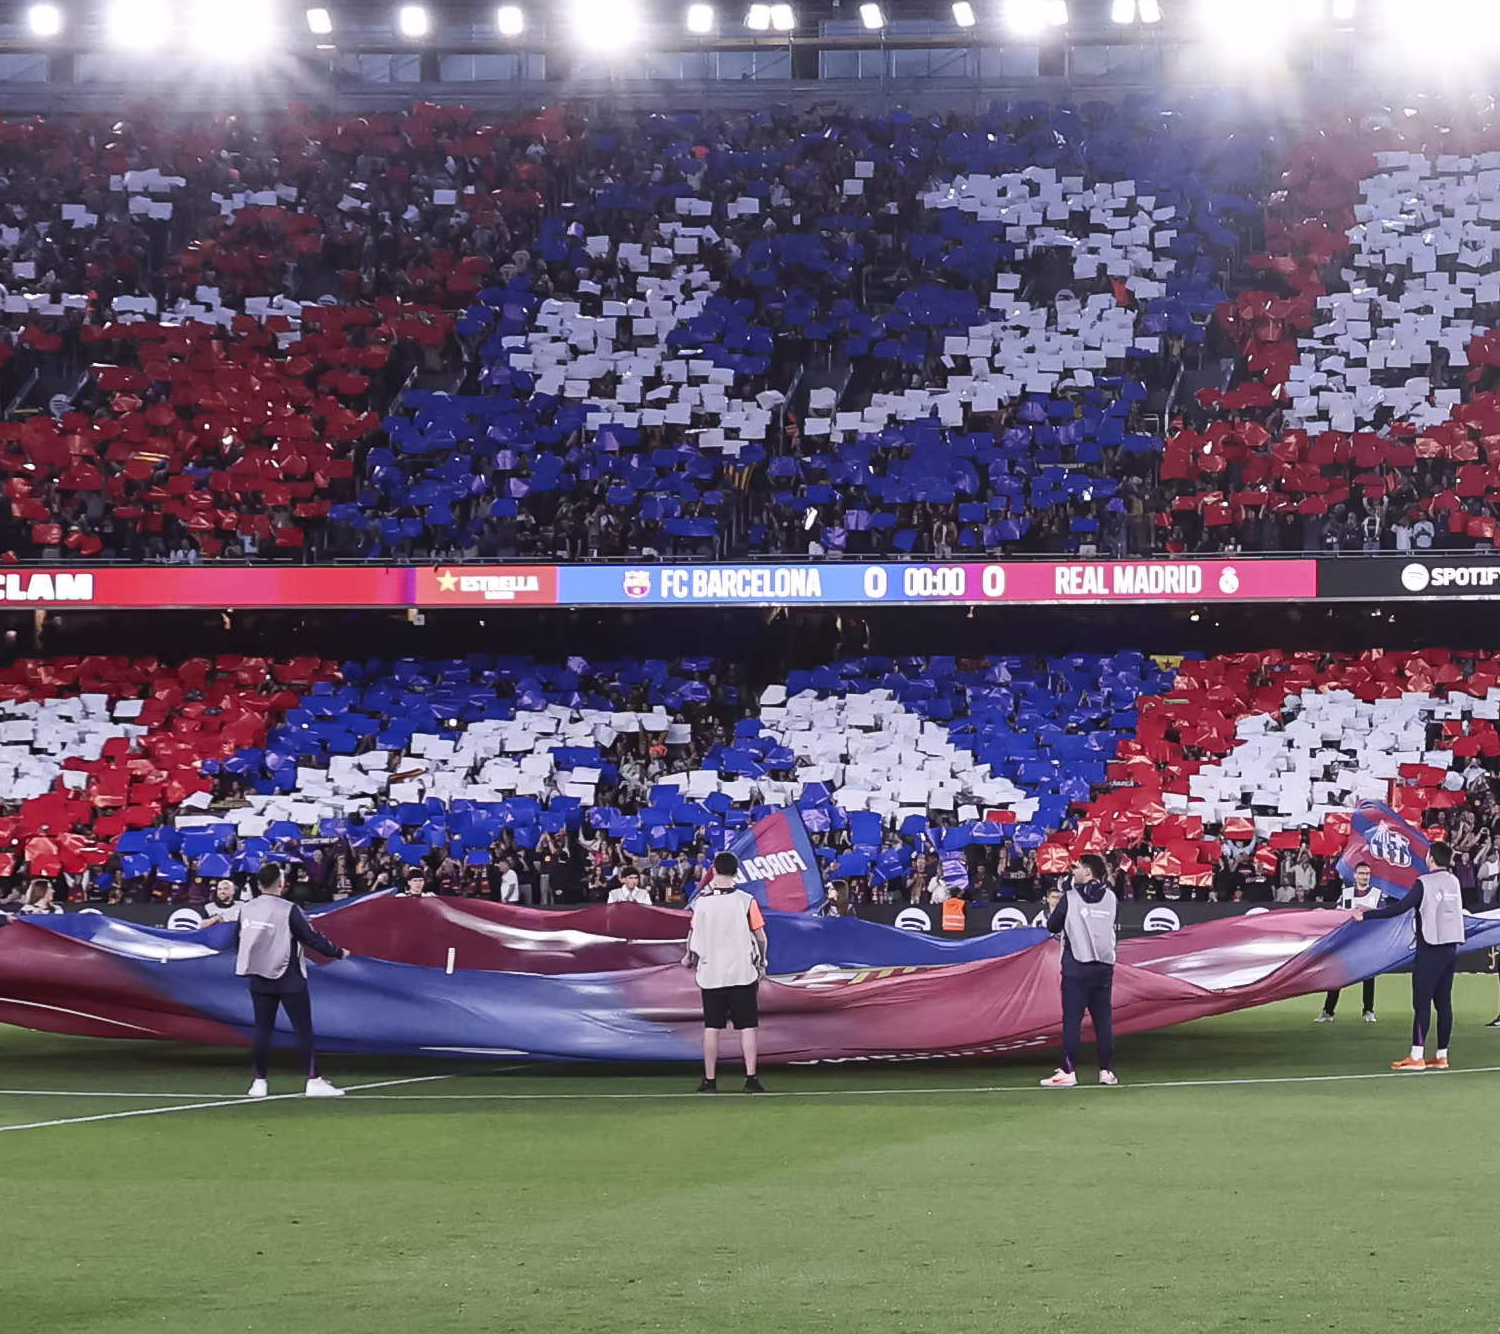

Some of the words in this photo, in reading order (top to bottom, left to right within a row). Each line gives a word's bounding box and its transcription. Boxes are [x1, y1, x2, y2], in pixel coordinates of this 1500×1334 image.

[460, 576, 539, 591] ESTRELLA
[660, 569, 688, 598] FC
[692, 568, 822, 598] BARCELONA
[863, 566, 887, 598] 0
[904, 567, 965, 596] 00:00
[982, 565, 1005, 597] 0
[1055, 566, 1109, 595] REAL
[1113, 565, 1201, 594] MADRID
